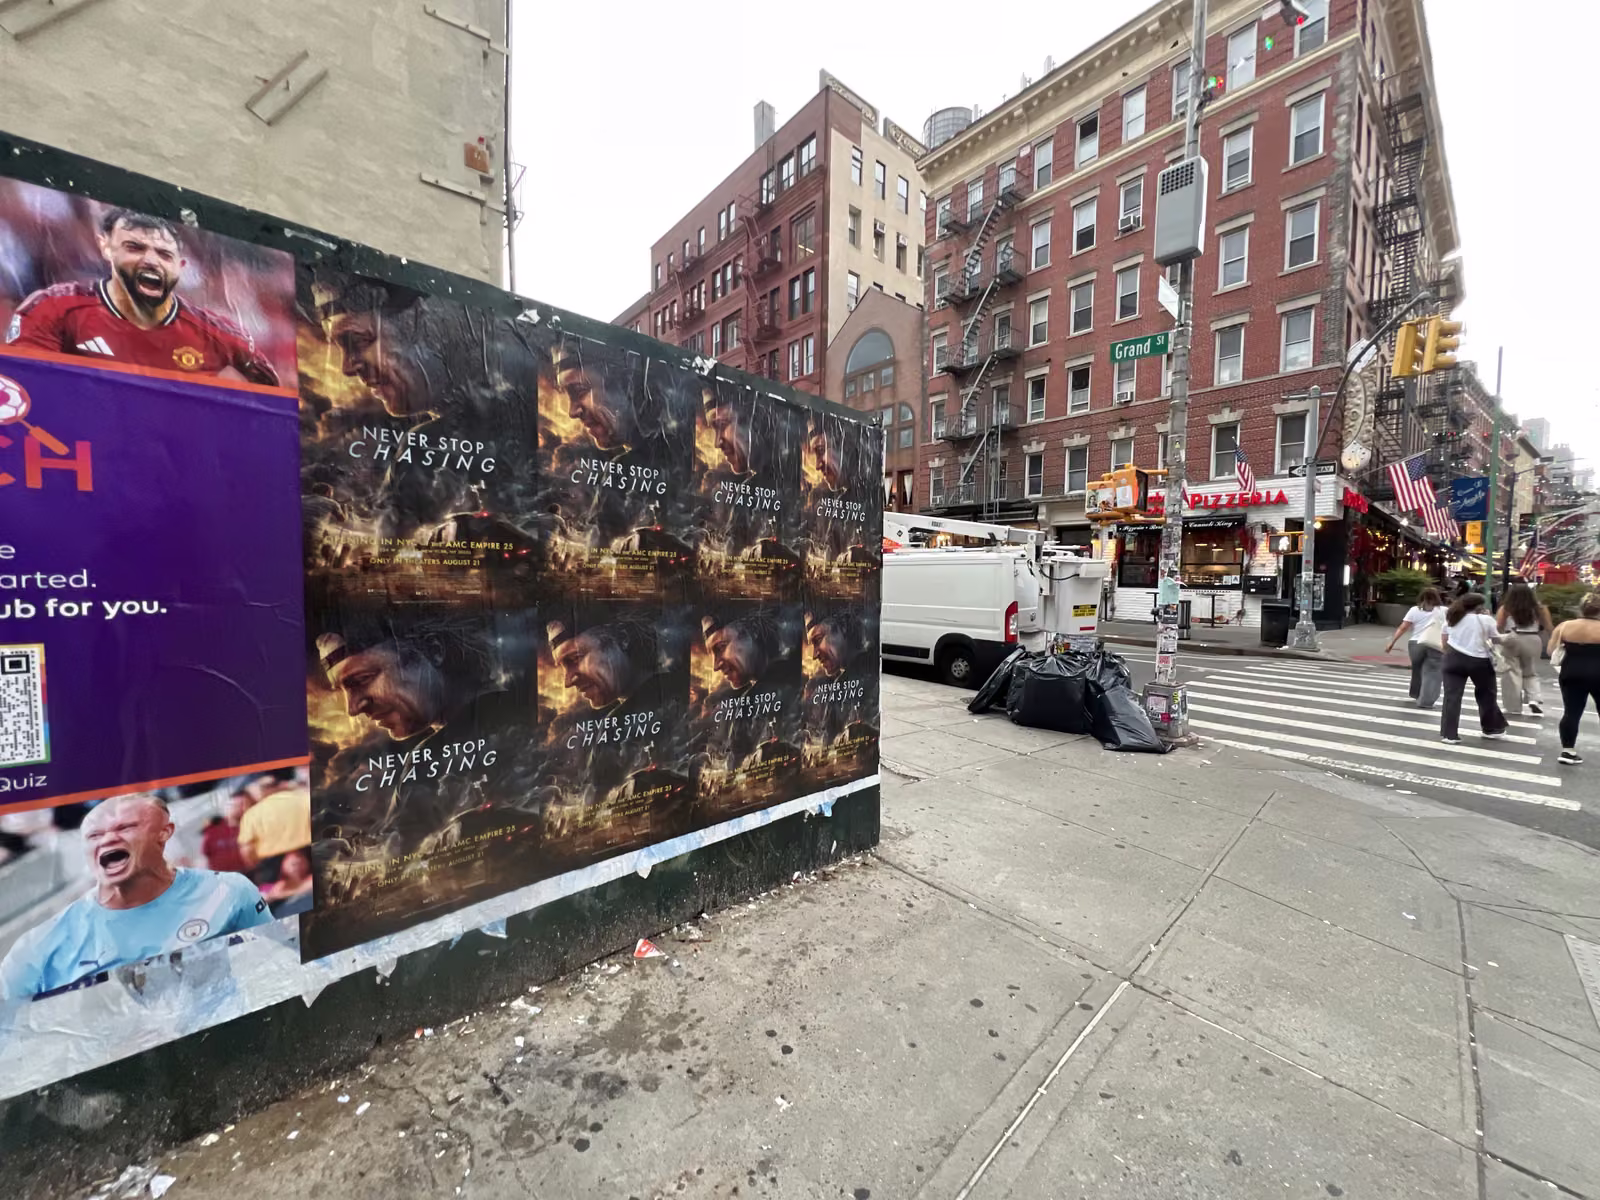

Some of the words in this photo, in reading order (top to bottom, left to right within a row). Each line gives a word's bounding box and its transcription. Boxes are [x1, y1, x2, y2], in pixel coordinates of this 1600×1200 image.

[1115, 338, 1151, 359] Grand
[363, 425, 428, 448] NEVER
[439, 436, 484, 455] STOP
[349, 441, 496, 472] CHASING
[580, 457, 623, 475] NEVER
[630, 465, 660, 480] STOP
[571, 469, 667, 495] CHASING
[720, 480, 750, 495] NEVER
[754, 486, 776, 498] STOP
[714, 490, 781, 512] CHASING
[821, 497, 843, 509] NEVER
[846, 501, 862, 512] STOP
[1190, 489, 1288, 510] PIZZERIA
[816, 506, 866, 522] CHASING
[1214, 520, 1232, 528] King
[446, 540, 467, 549] AMC
[470, 542, 500, 550] EMPIRE
[503, 542, 514, 550] 25
[0, 568, 96, 589] arted.
[46, 598, 93, 618] for
[102, 600, 168, 620] you.
[813, 688, 864, 705] CHASING
[817, 682, 840, 694] NEVER
[843, 680, 860, 690] STOP
[720, 696, 750, 709] NEVER
[754, 692, 776, 704] STOP
[714, 700, 782, 723] CHASING
[576, 716, 618, 734] NEVER
[624, 711, 654, 726] STOP
[566, 721, 662, 750] CHASING
[368, 748, 432, 772] NEVER
[442, 738, 486, 758] STOP
[355, 750, 497, 792] CHASING
[0, 773, 48, 792] Quiz
[450, 837, 472, 848] AMC
[474, 828, 504, 842] EMPIRE
[448, 853, 474, 867] AUGUST
